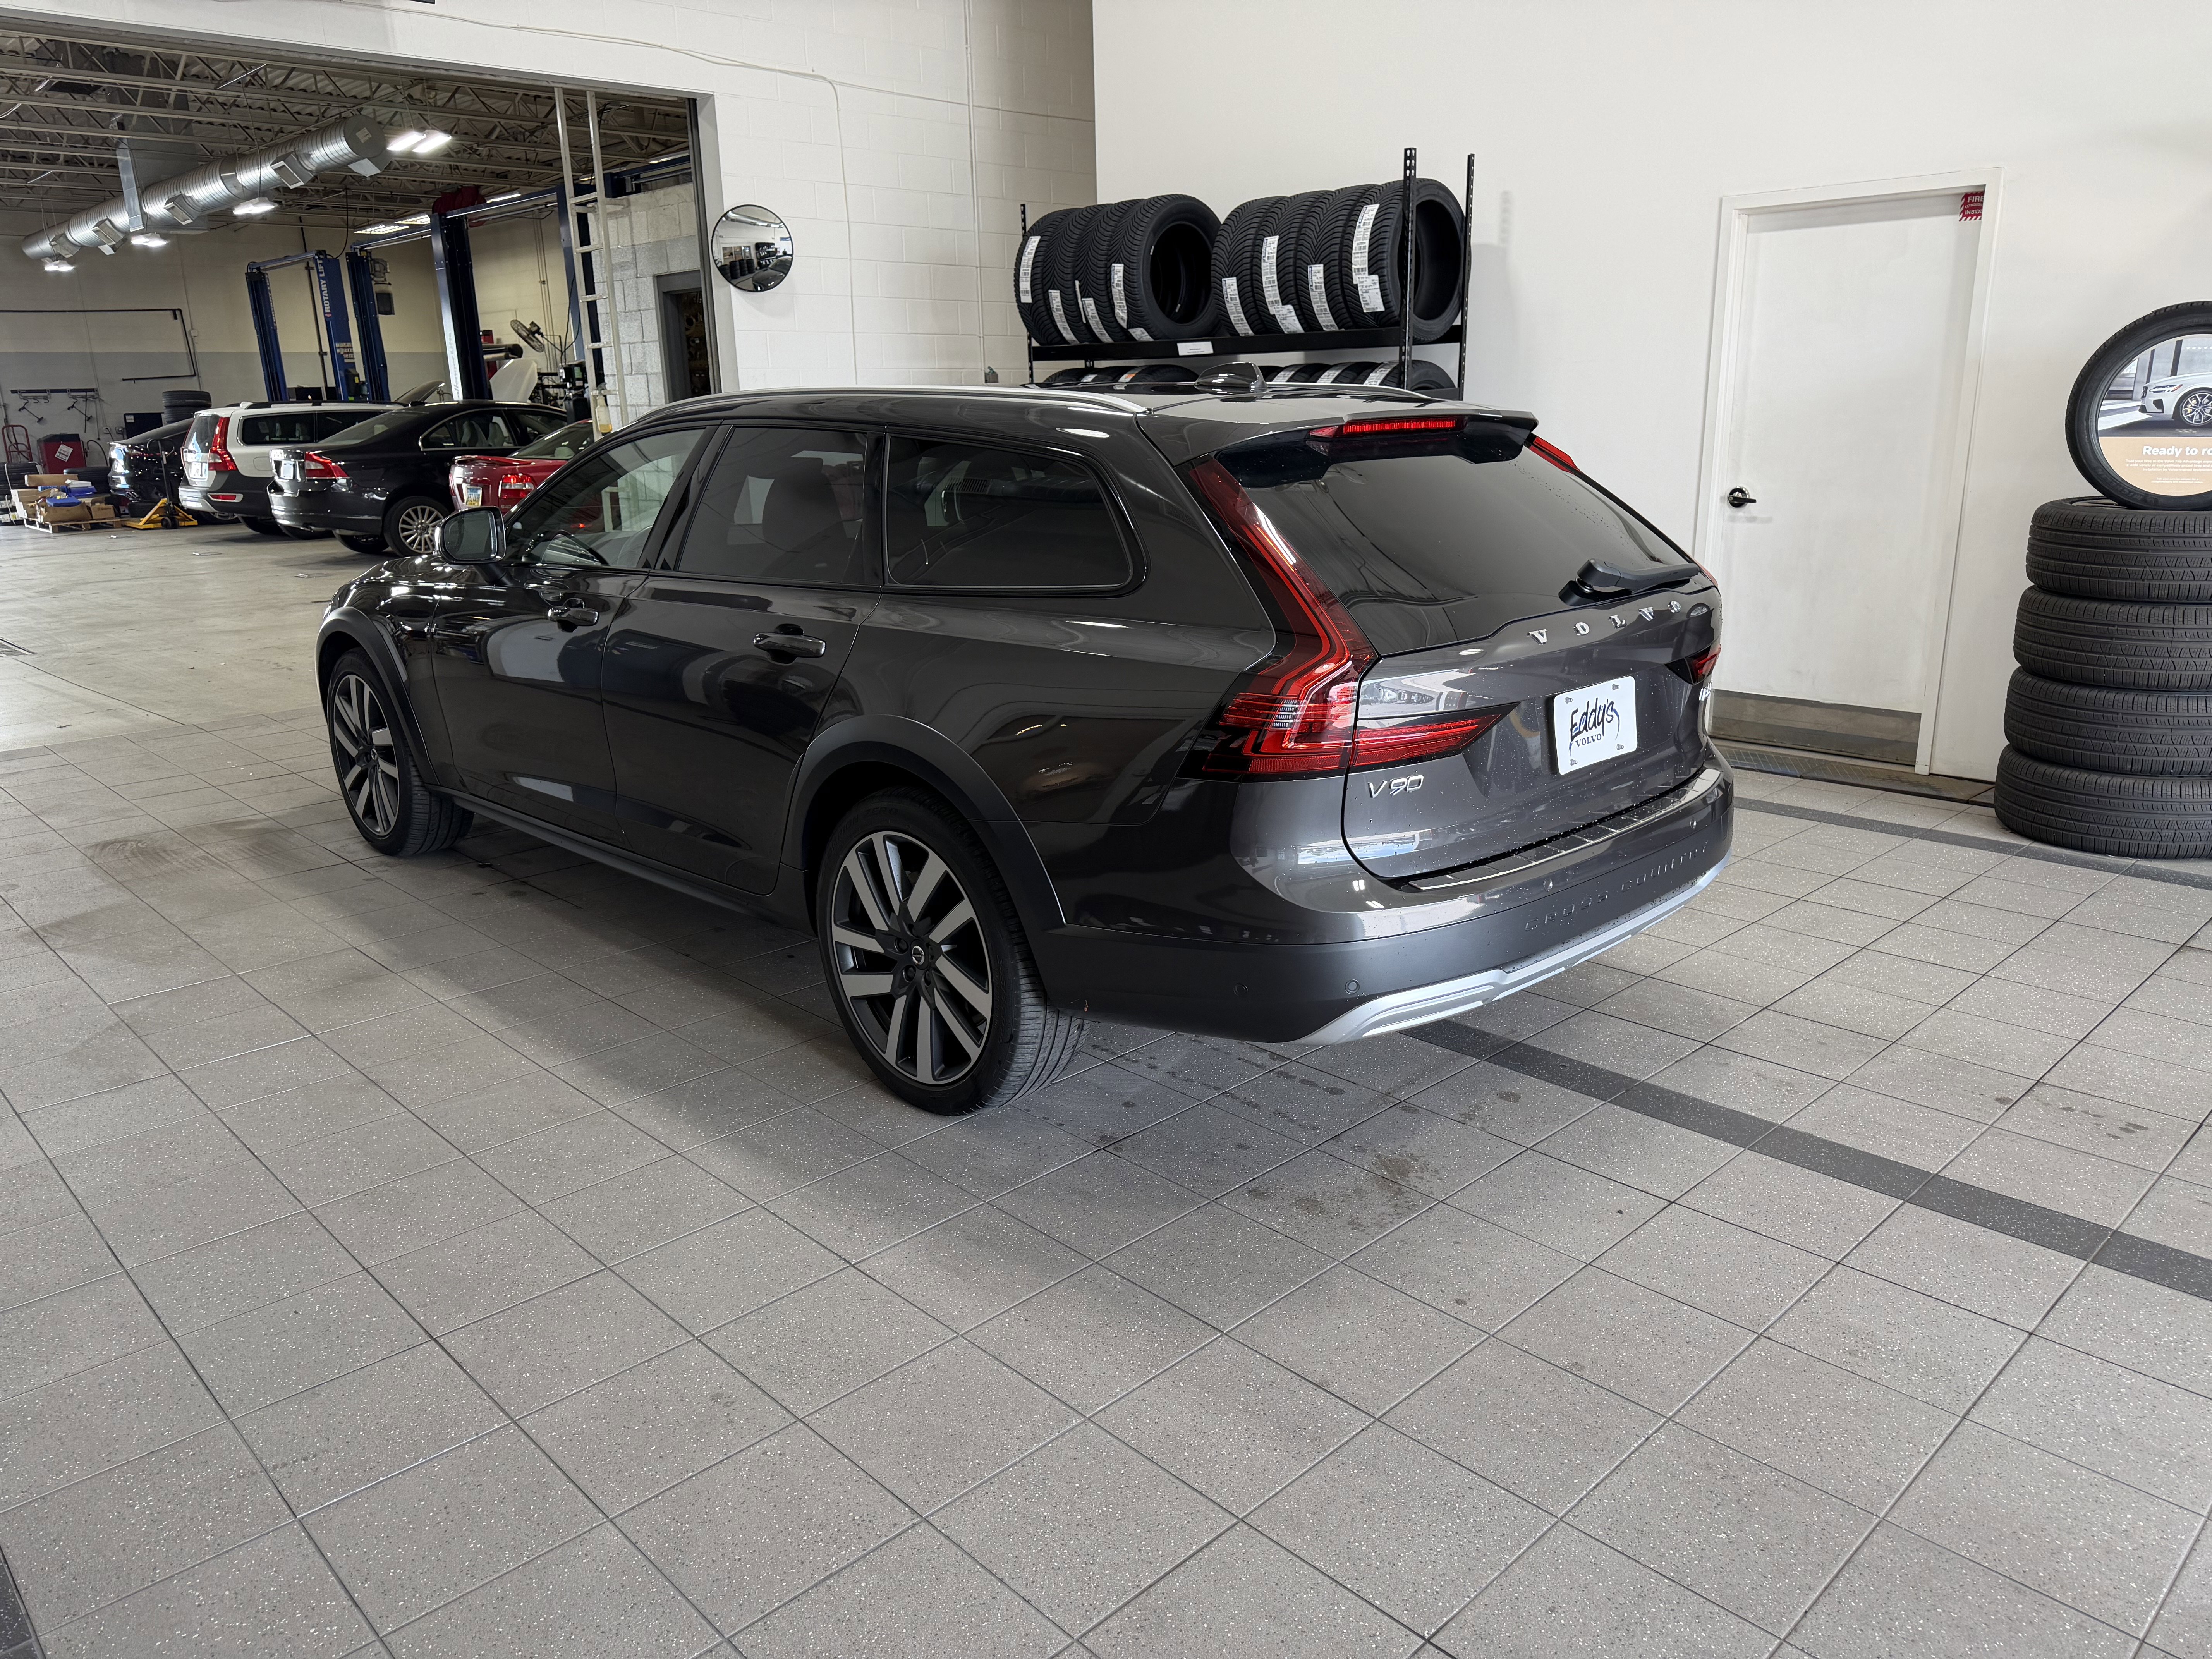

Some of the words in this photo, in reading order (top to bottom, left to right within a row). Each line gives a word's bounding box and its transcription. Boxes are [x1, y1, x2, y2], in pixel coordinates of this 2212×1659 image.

[320, 279, 331, 313] ROTARY
[2142, 446, 2183, 457] Ready
[2185, 447, 2198, 455] to
[1527, 600, 1682, 645] VOLVO
[1570, 697, 1614, 742] Eddy's
[1575, 733, 1602, 747] VOLVO
[1367, 775, 1424, 798] V90
